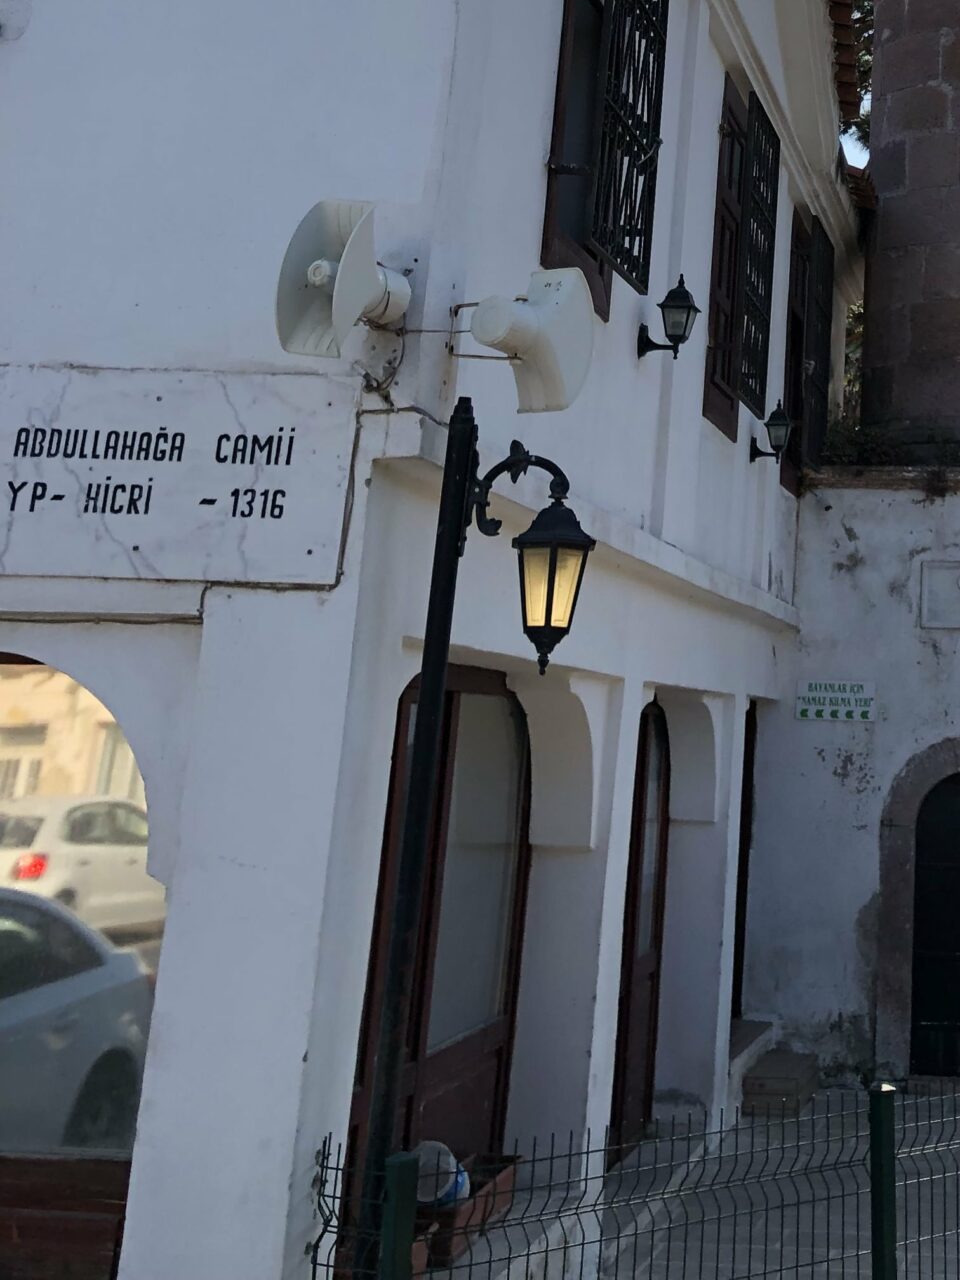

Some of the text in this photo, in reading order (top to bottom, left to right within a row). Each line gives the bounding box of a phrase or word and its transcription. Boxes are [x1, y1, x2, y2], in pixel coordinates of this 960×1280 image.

[13, 426, 297, 466] ABDULLAHAĞA CAMİİ
[83, 476, 154, 515] HİCRİ
[230, 488, 287, 519] 1316
